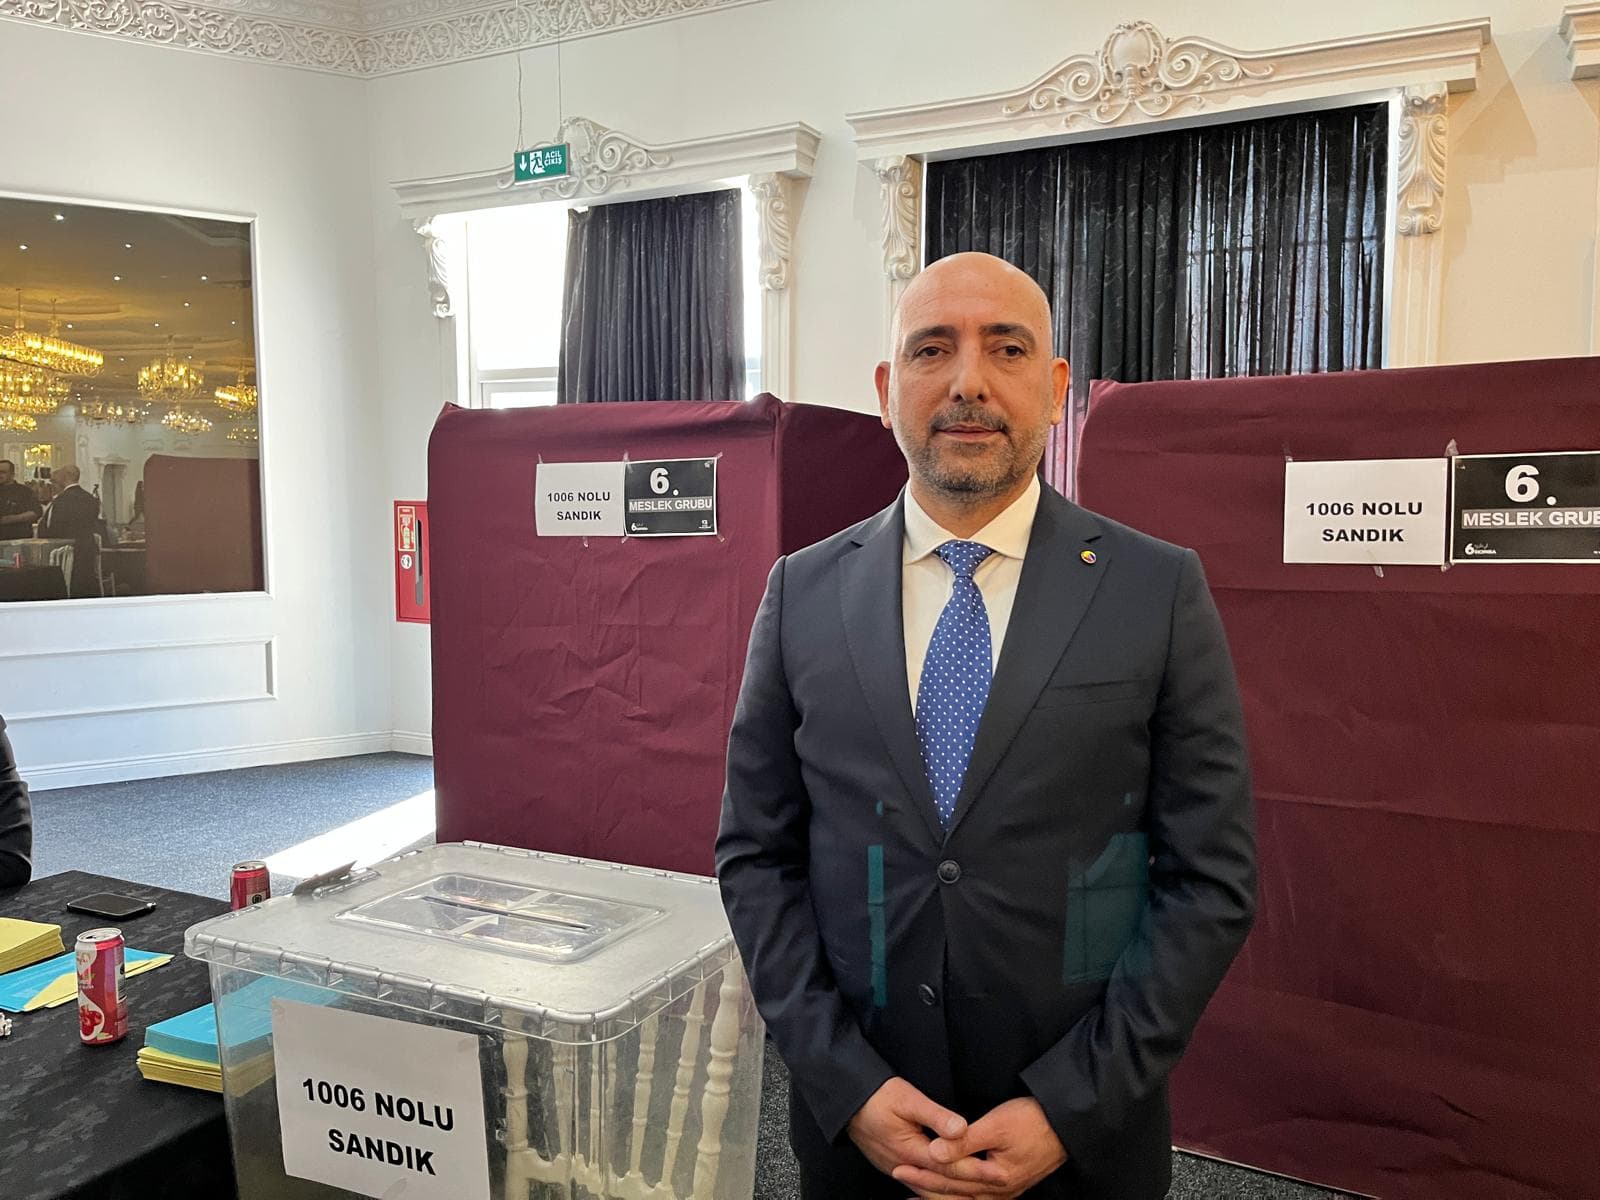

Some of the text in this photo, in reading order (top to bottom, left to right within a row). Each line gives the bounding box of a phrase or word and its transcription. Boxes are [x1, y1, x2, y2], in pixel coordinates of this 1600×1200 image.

[650, 467, 679, 496] 6.
[1504, 464, 1557, 506] 6.
[547, 491, 611, 502] 1006 NOLU
[629, 498, 712, 511] MESLEK GRUBU
[1305, 502, 1423, 516] 1006 NOLU
[556, 510, 602, 520] SANDIK
[1463, 511, 1543, 527] MESLEK
[1321, 528, 1405, 542] SANDIK
[302, 1077, 454, 1131] 1006 NOLU
[328, 1128, 437, 1176] SANDIK
